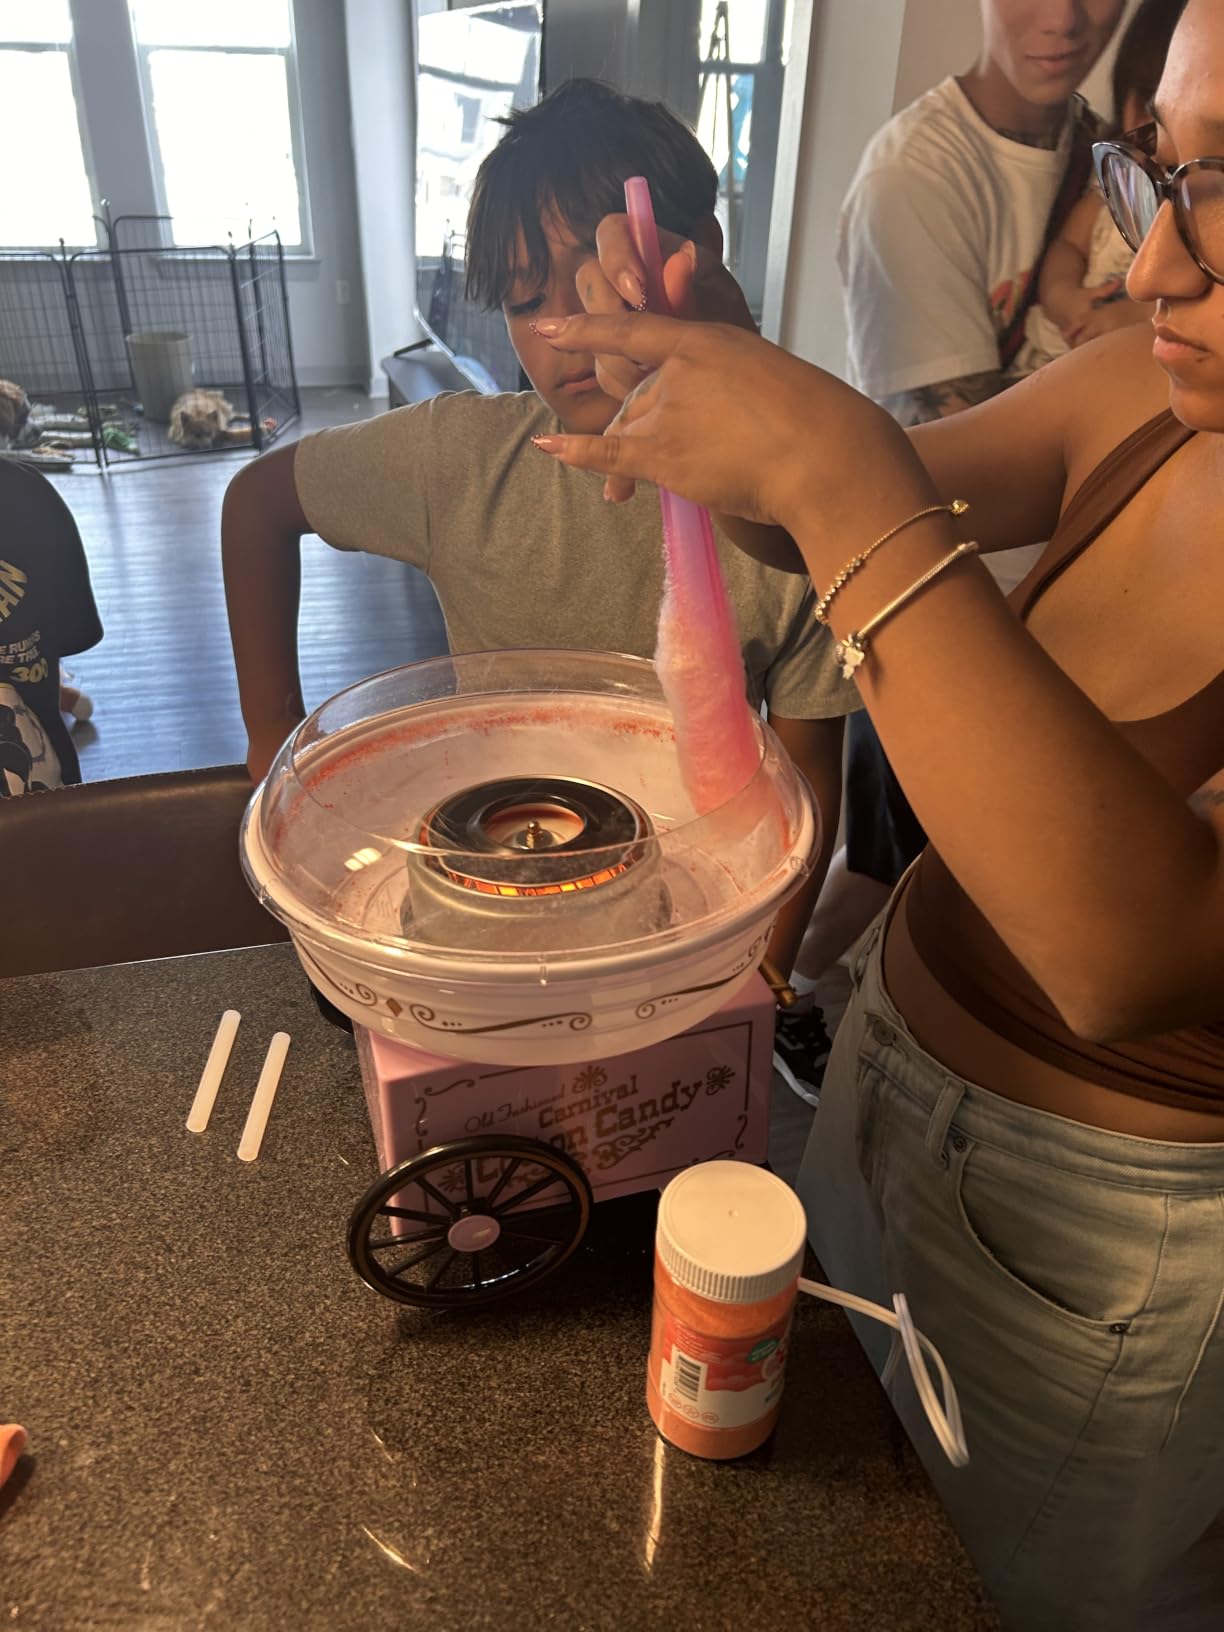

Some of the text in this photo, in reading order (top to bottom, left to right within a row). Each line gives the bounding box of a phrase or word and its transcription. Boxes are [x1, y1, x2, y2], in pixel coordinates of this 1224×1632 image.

[463, 1110, 496, 1133] Old
[538, 1074, 639, 1128] Carnival
[595, 1079, 703, 1138] Candy
